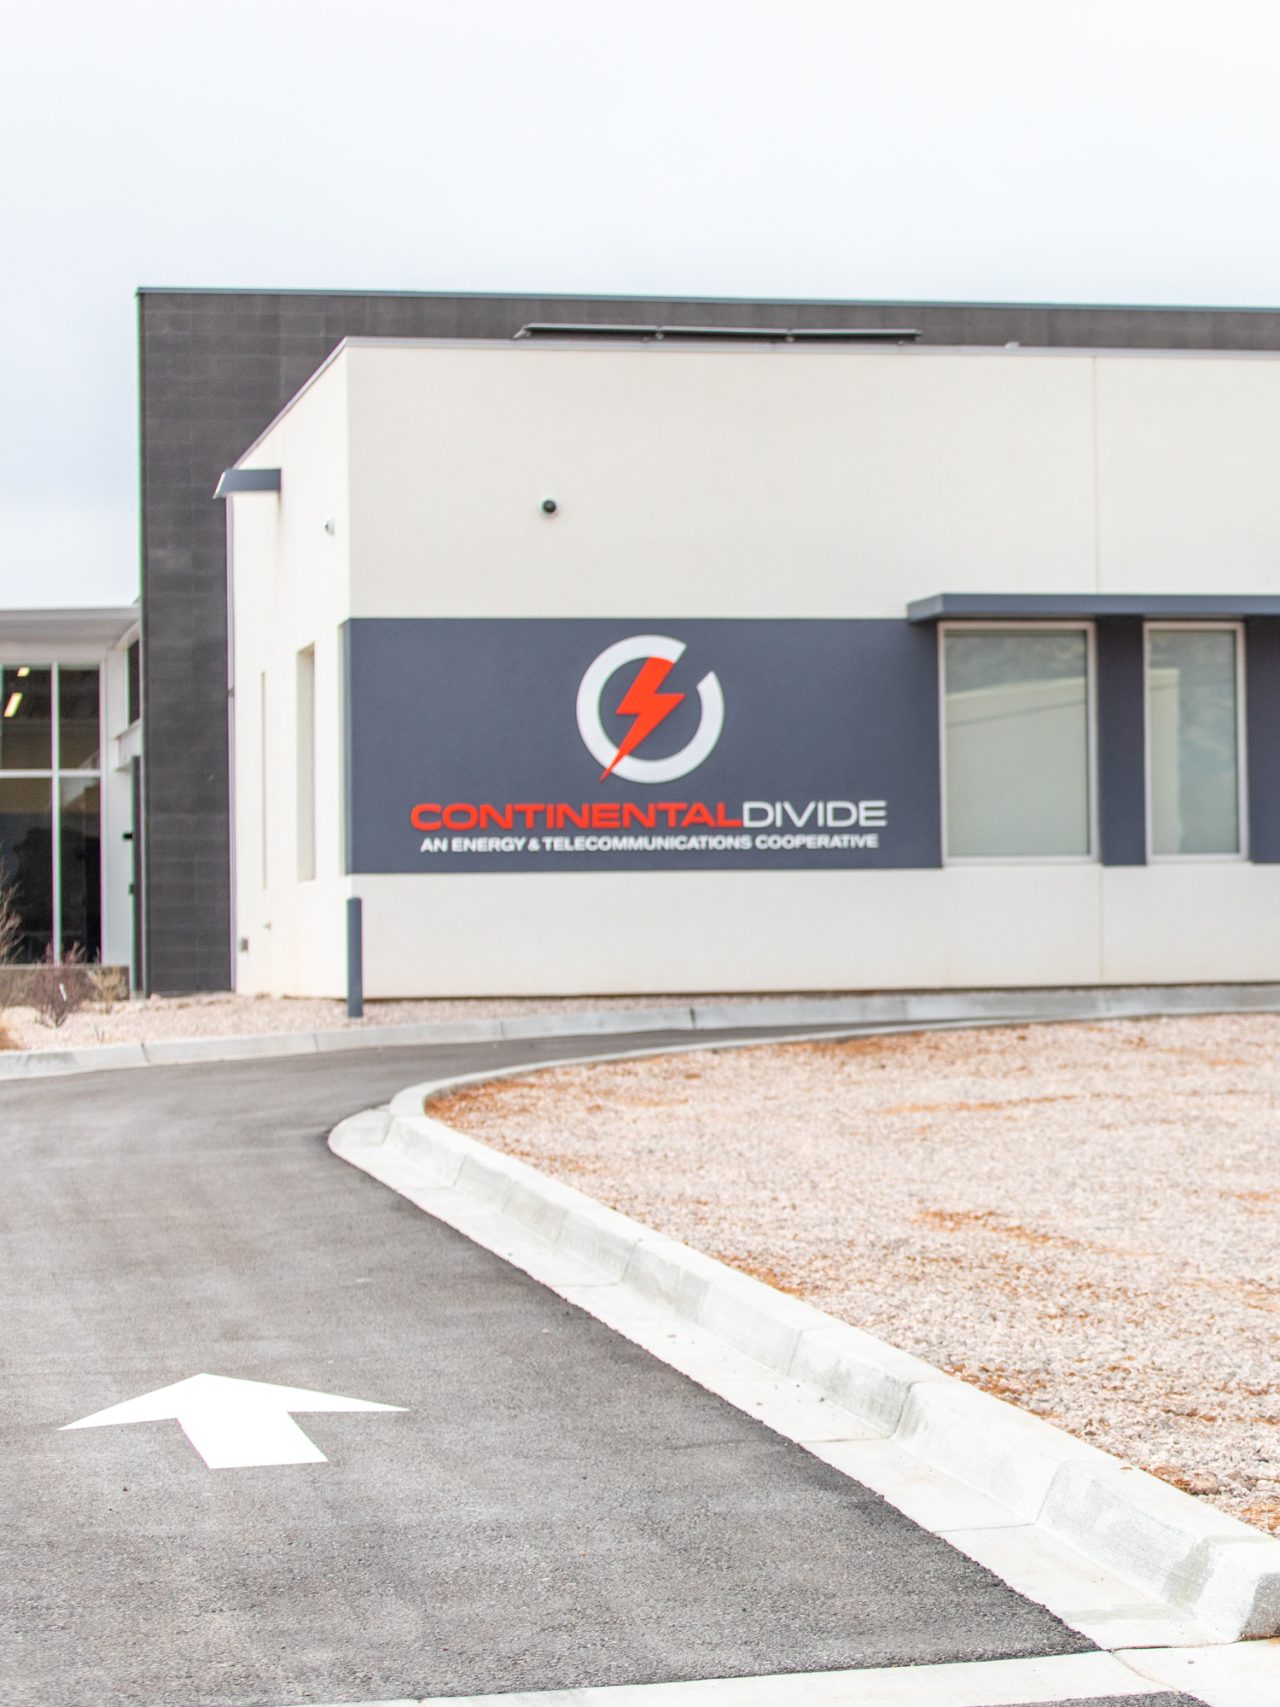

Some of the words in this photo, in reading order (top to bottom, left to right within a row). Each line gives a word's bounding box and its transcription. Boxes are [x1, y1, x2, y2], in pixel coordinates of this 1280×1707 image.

[420, 837, 449, 853] AN
[451, 836, 527, 853] ENERGY
[527, 838, 541, 852] &
[542, 834, 753, 852] TELECOMMUNICATIONS
[754, 833, 879, 850] COOPERATIVE
